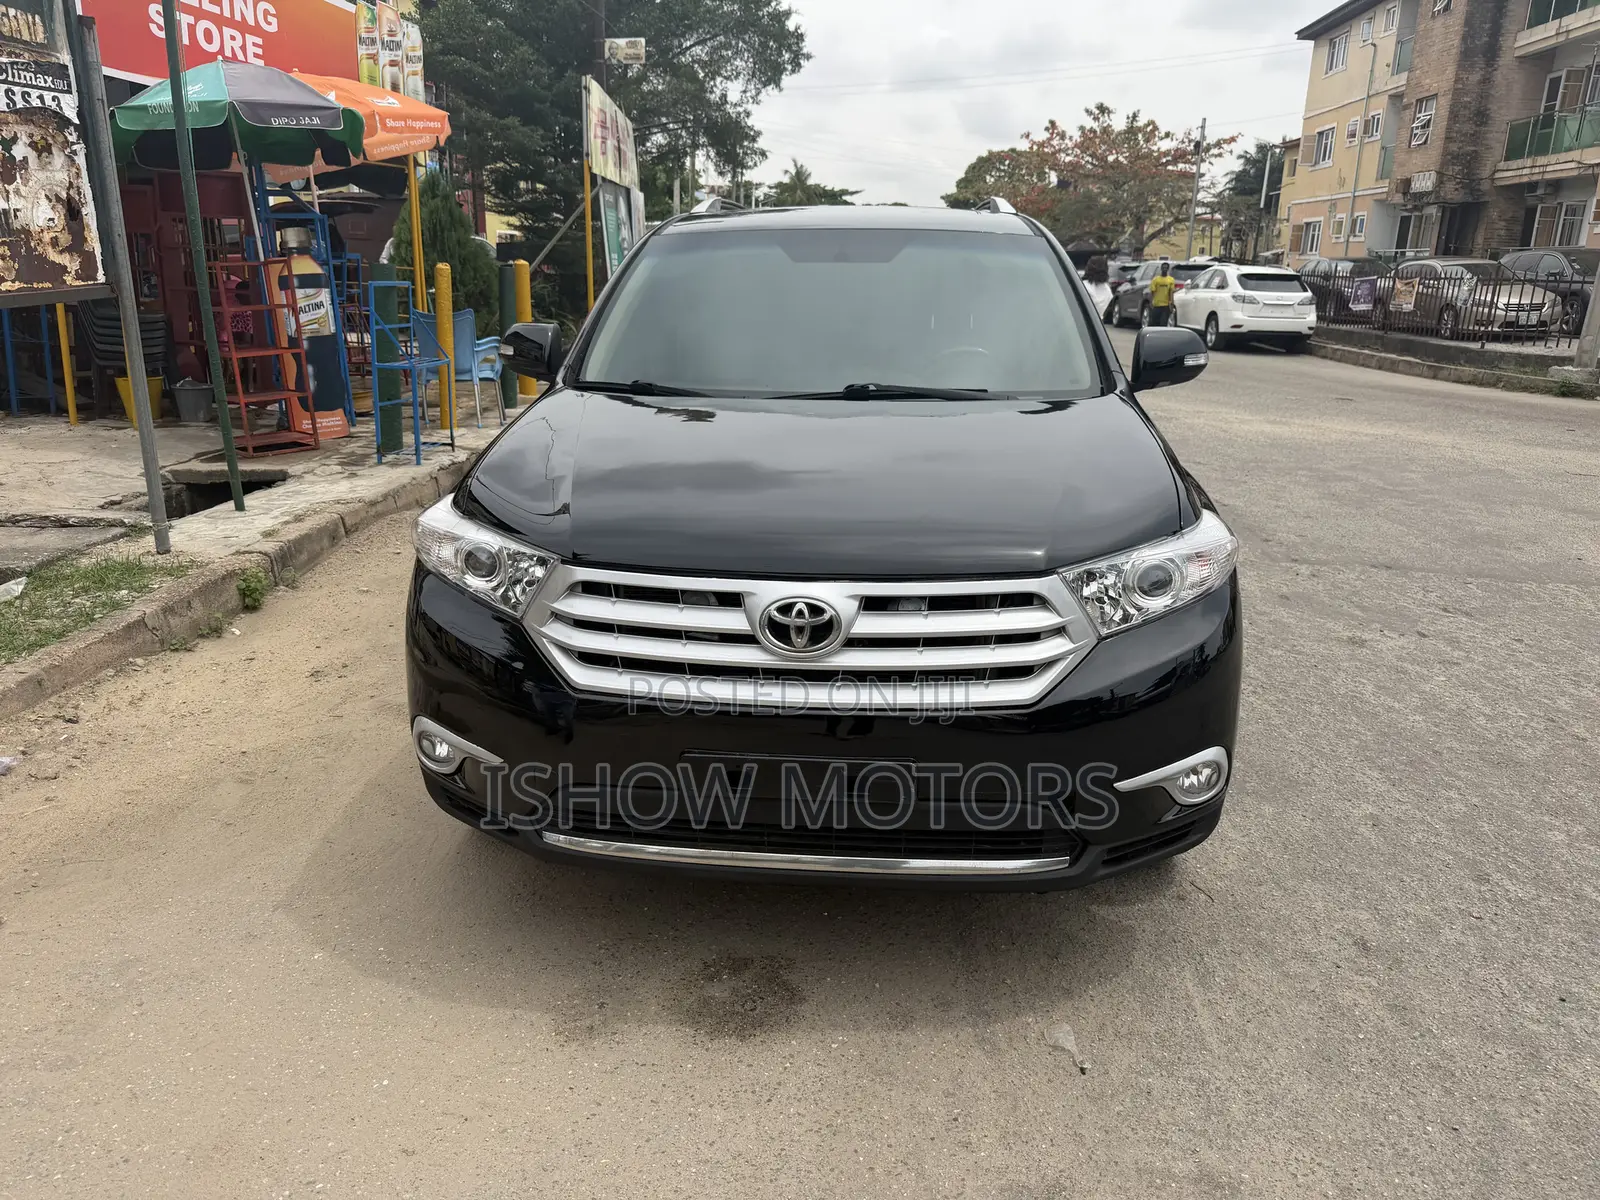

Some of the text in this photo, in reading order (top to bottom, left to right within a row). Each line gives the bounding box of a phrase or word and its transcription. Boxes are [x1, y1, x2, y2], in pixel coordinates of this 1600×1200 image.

[148, 3, 265, 66] STORE
[271, 116, 321, 125] DIPO JAJI
[385, 118, 441, 129] Share Happiness
[293, 301, 325, 316] ALTINA
